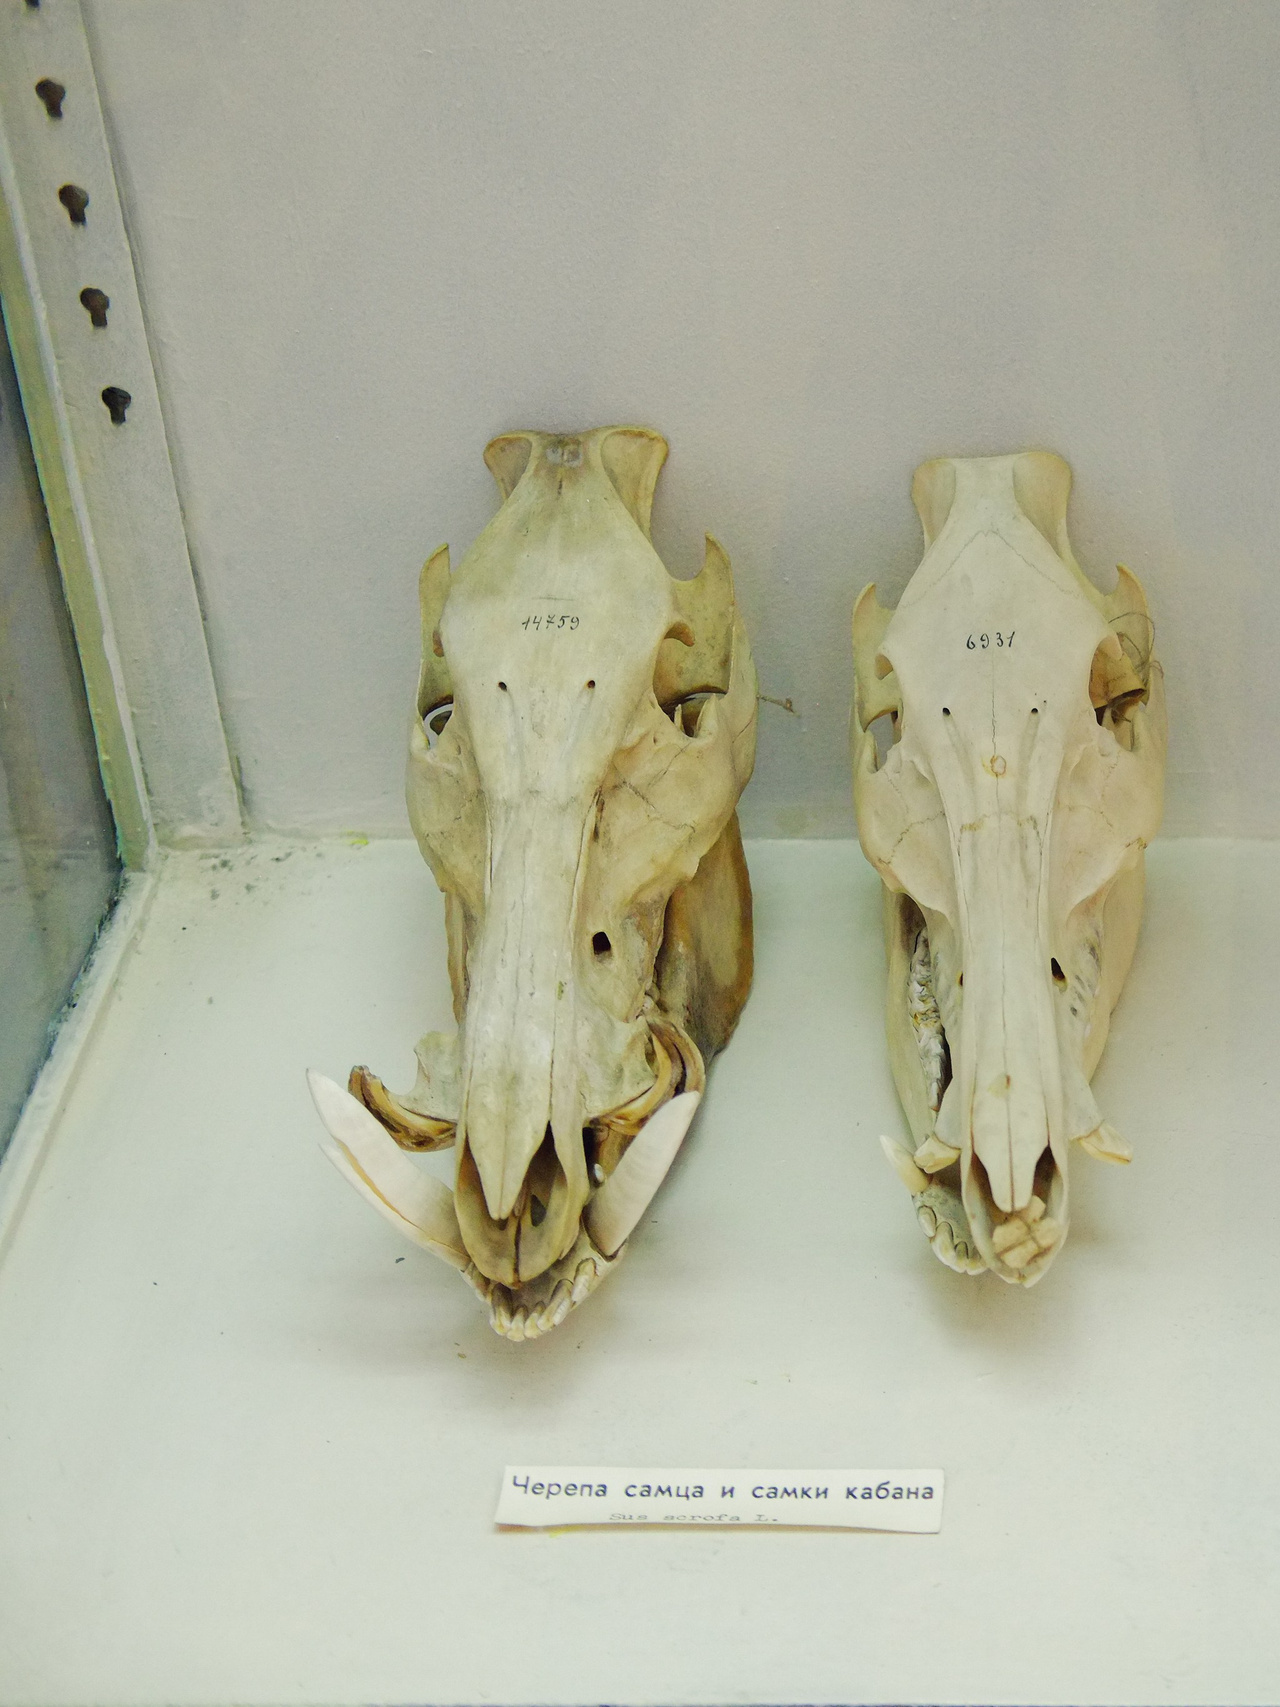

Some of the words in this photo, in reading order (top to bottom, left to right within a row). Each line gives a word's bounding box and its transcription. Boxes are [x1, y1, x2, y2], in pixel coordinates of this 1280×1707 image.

[521, 614, 580, 631] 14759
[966, 631, 1015, 650] 6931
[512, 1475, 608, 1500] Черепа
[623, 1483, 704, 1501] самца
[720, 1485, 735, 1499] и
[751, 1484, 829, 1500] самки
[845, 1480, 935, 1500] кабана
[609, 1513, 648, 1521] Sus
[754, 1514, 779, 1522] L.
